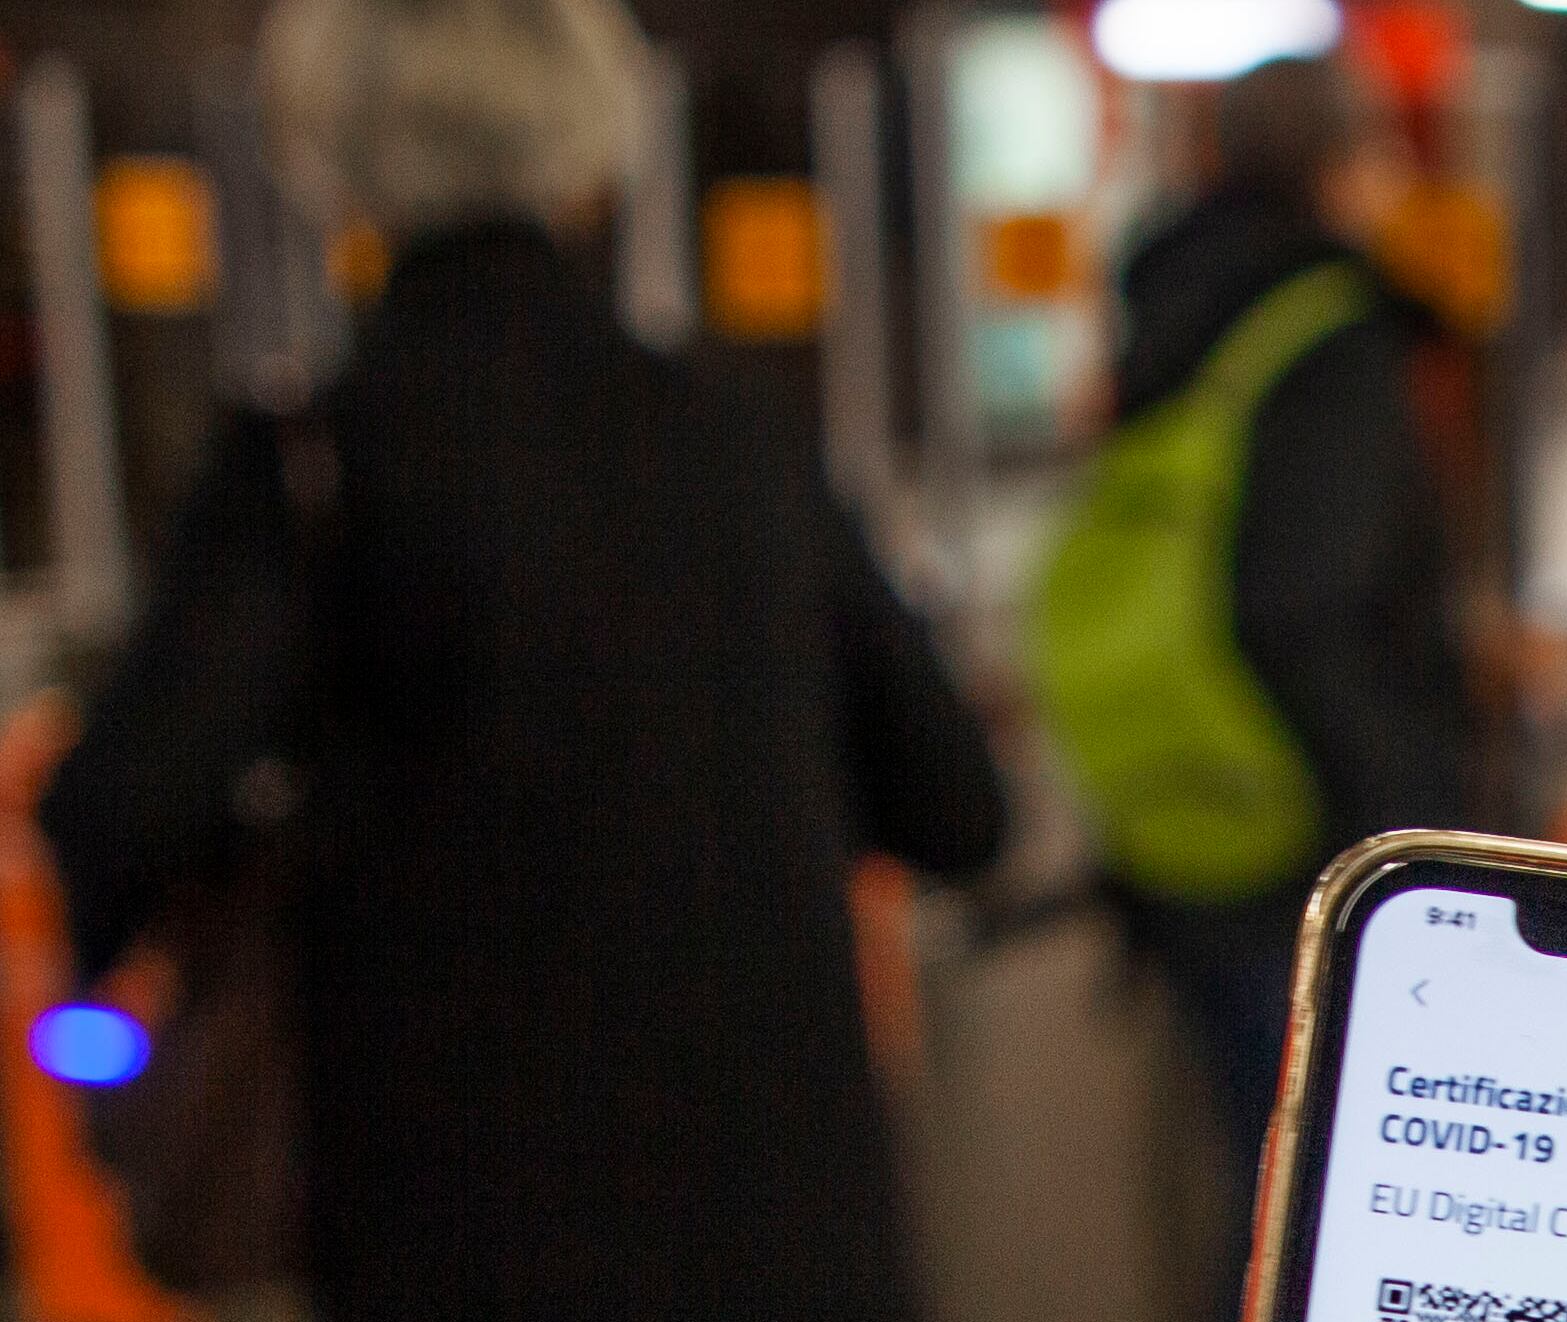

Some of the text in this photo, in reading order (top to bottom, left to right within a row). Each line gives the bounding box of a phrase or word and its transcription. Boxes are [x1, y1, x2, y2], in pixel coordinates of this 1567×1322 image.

[1424, 905, 1477, 930] 9:41
[1379, 1113, 1556, 1164] COVID-19
[1369, 1182, 1421, 1217] EU
[1428, 1187, 1540, 1237] Digital
